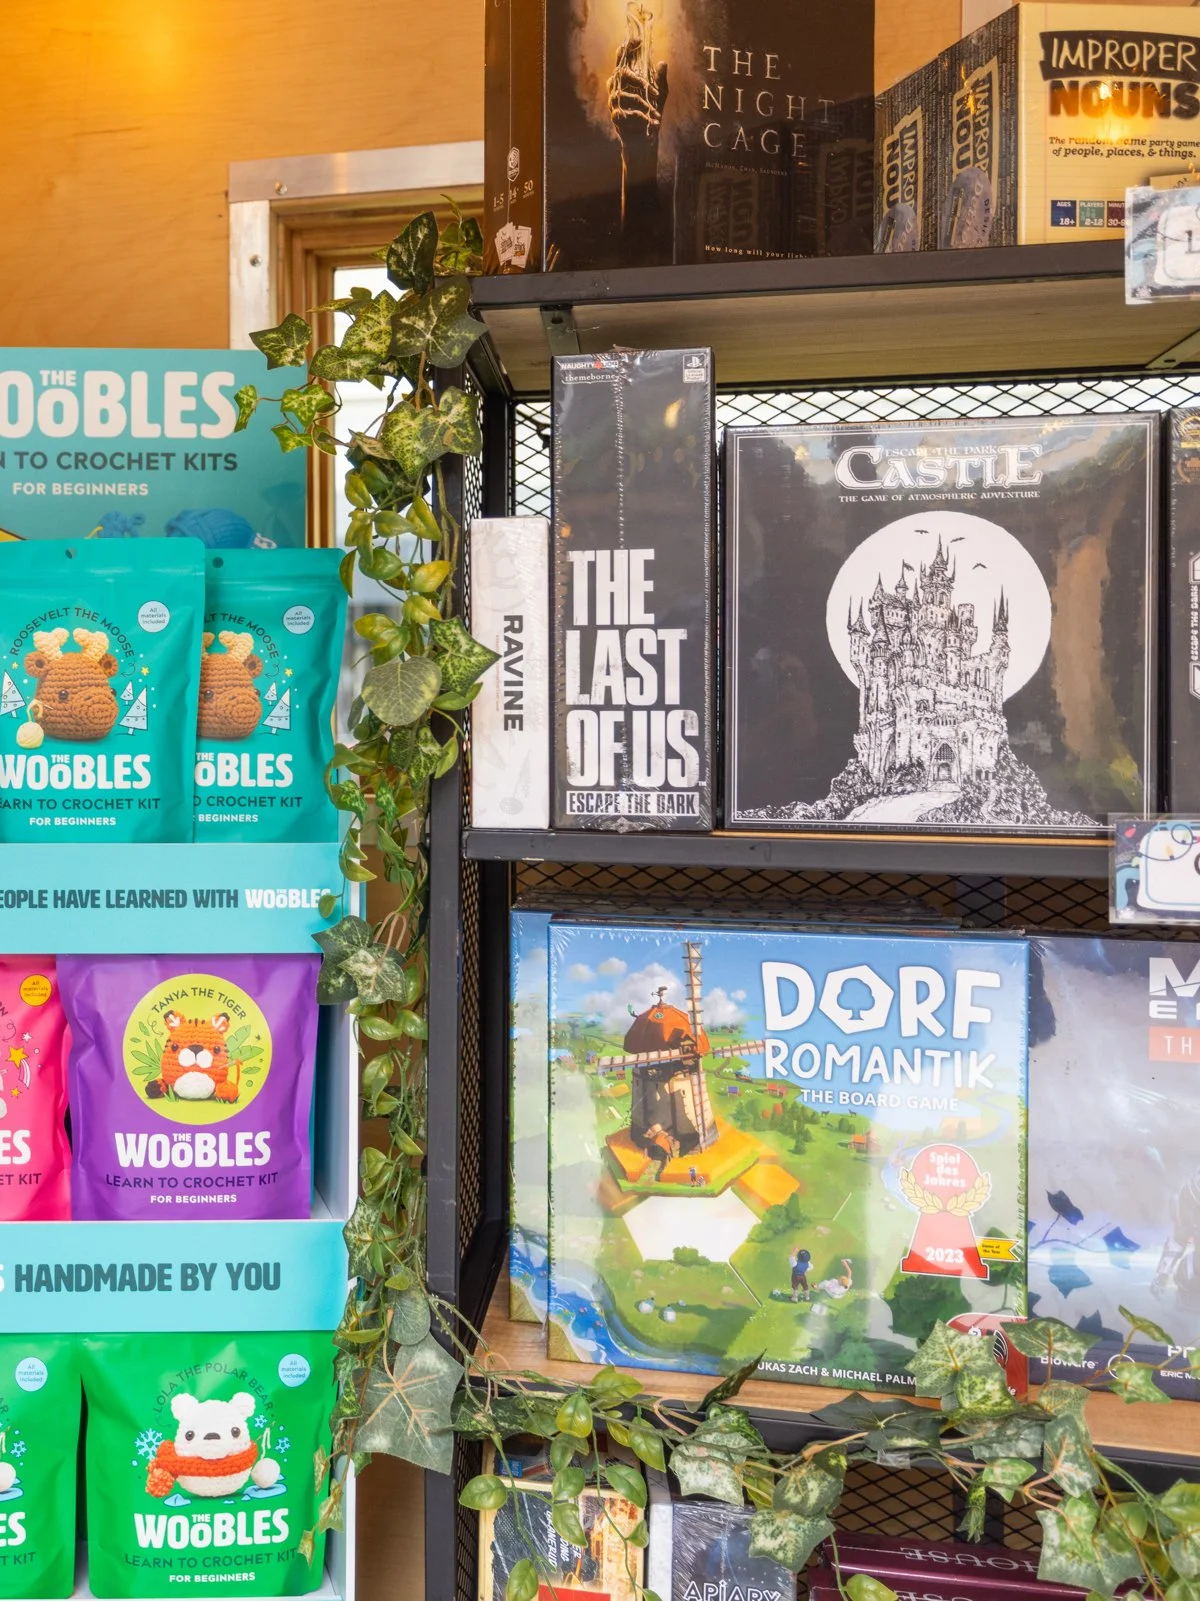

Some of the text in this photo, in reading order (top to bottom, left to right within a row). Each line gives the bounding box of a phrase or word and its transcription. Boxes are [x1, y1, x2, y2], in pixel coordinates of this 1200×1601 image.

[703, 46, 781, 81] THE
[1051, 37, 1197, 73] IMPROPER
[702, 84, 836, 124] NIGHT
[1050, 80, 1200, 120] NOUNS
[703, 122, 807, 158] CAGE
[1052, 147, 1197, 160] of people, places, & things.
[1059, 218, 1075, 226] 18+
[705, 245, 721, 253] How
[725, 247, 743, 256] long
[747, 249, 763, 257] will
[766, 251, 784, 259] your
[40, 370, 76, 387] THE
[14, 451, 48, 471] TO
[56, 451, 176, 471] CROCHET
[184, 452, 238, 471] KITS
[834, 444, 1043, 490] CASTLE
[12, 482, 149, 497] FOR BEGINNERS
[839, 490, 1041, 503] THE GAME OF ATMOSPHERIC ADVENTURE
[566, 548, 656, 626] THE
[220, 611, 246, 625] THE
[246, 619, 280, 659] MOOSE
[503, 614, 524, 732] RAVINE
[565, 628, 688, 706] LAST
[565, 709, 699, 788] OF US
[206, 796, 303, 808] CROCHET KIT
[569, 793, 697, 814] ESCAPE THE DARK
[29, 816, 117, 826] FOR BEGINNERS
[53, 888, 100, 909] HAVE
[105, 888, 188, 909] LEARNED
[193, 888, 239, 908] WITH
[761, 960, 1002, 1040] DORF
[764, 1038, 997, 1090] ROMANTIK
[800, 1088, 959, 1112] THE BOARD GAME
[929, 1151, 961, 1166] Spiel
[19, 1173, 42, 1185] KIT
[106, 1172, 279, 1188] LEARN TO CROCHET KIT
[924, 1174, 967, 1188] Jahres
[936, 1165, 959, 1176] des
[150, 1194, 237, 1204] FOR BEGINNERS
[925, 1246, 965, 1263] 2023
[14, 1263, 173, 1293] HANDMADE
[180, 1262, 218, 1292] BY
[225, 1261, 282, 1292] YOU
[756, 1362, 917, 1385] UKAS ZACH & MICHAEL PALM
[1160, 1370, 1184, 1379] ERIC
[155, 1362, 273, 1414] LOLA THE POLAR BEAR
[169, 1572, 256, 1583] FOR BEGINNERS
